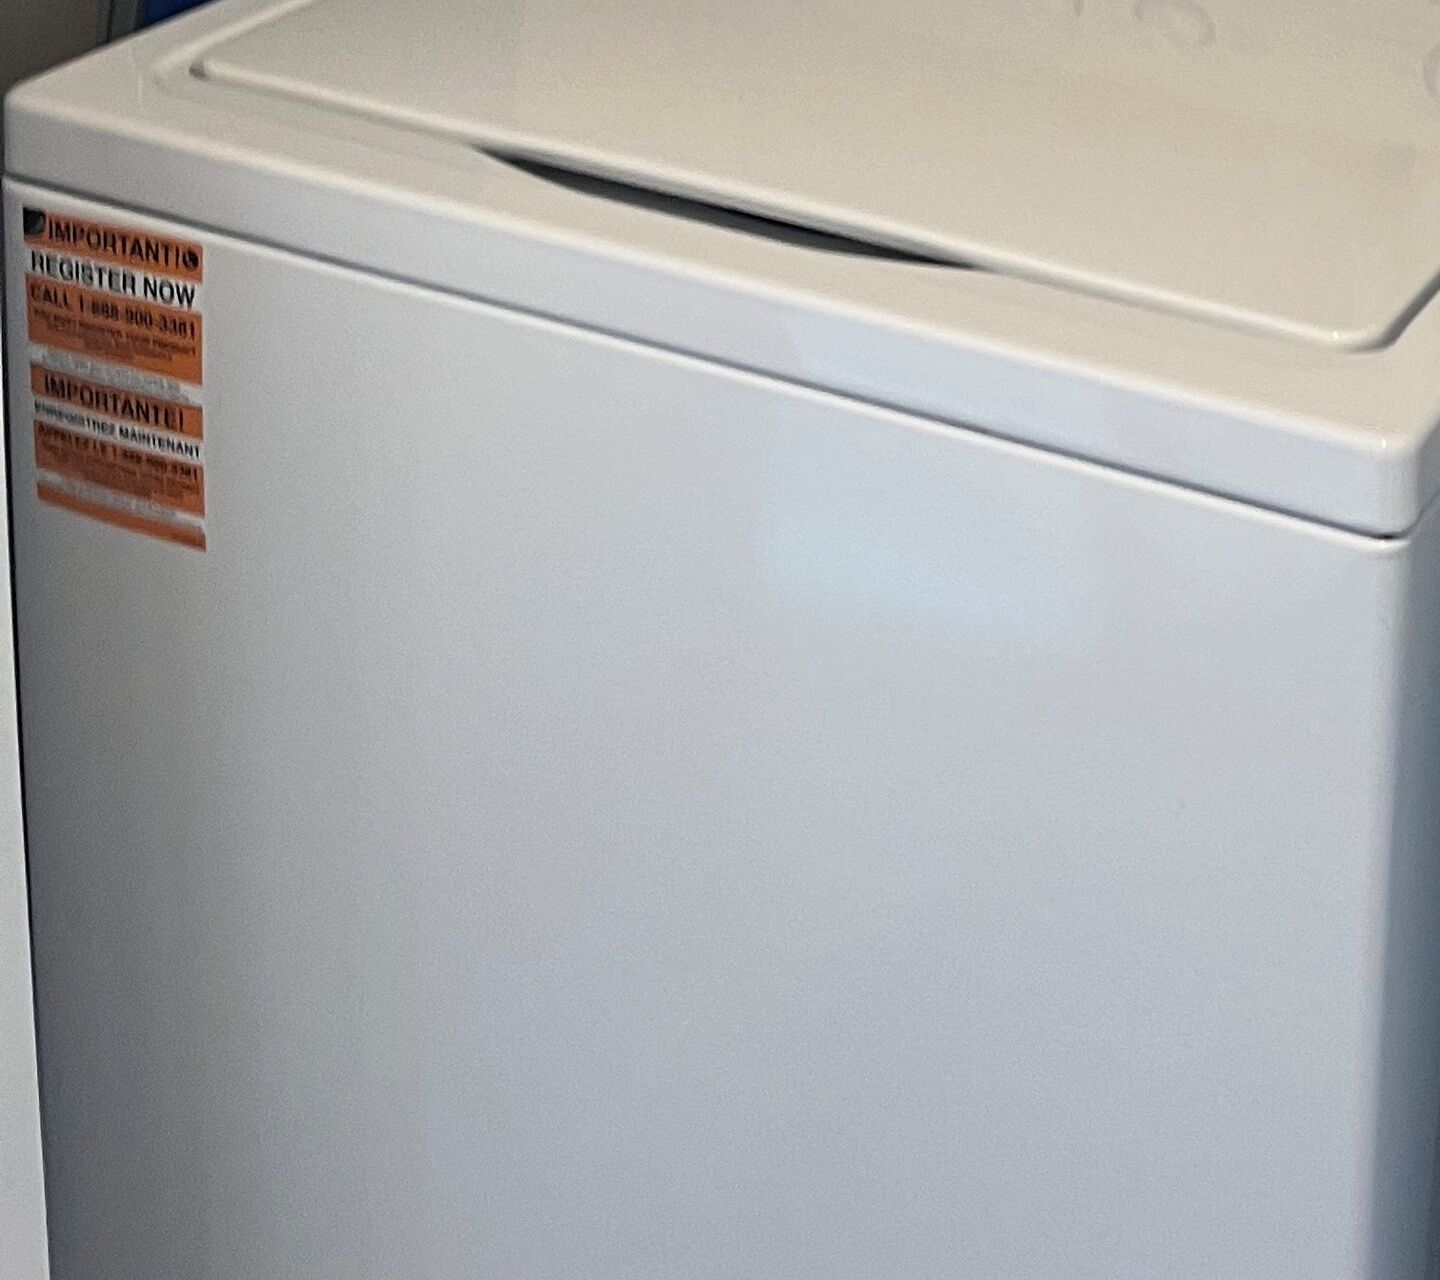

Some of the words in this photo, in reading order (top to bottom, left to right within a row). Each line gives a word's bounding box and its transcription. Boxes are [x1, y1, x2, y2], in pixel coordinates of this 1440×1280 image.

[48, 219, 180, 269] IMPORTANT!
[31, 249, 136, 297] REGISTER
[143, 275, 195, 310] NOW
[118, 424, 199, 459] MAINTENANT
